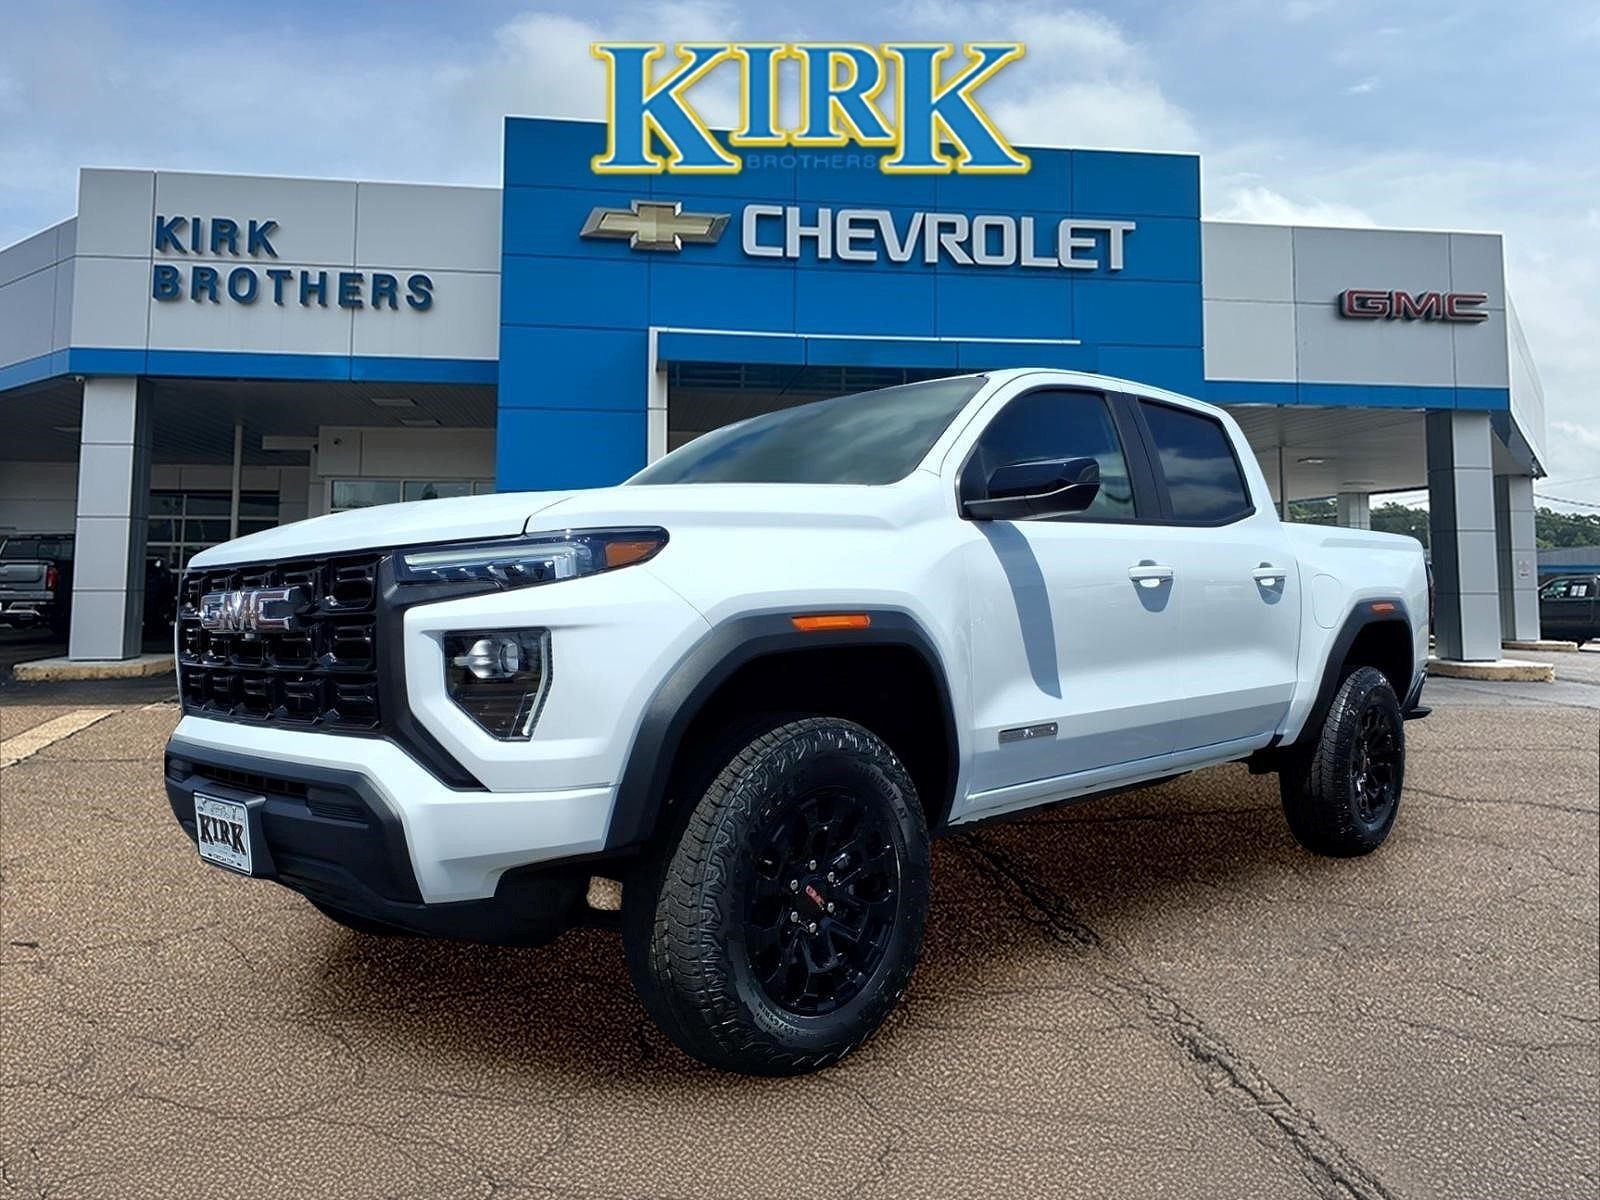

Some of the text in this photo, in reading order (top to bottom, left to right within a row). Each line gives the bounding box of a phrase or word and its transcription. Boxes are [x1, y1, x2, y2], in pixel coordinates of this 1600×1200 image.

[155, 216, 279, 258] KIRK
[742, 204, 1136, 270] CHEVROLET
[152, 265, 434, 311] BROTHERS
[1342, 288, 1488, 321] GMC
[200, 588, 290, 631] GMC
[198, 814, 247, 856] KIRK
